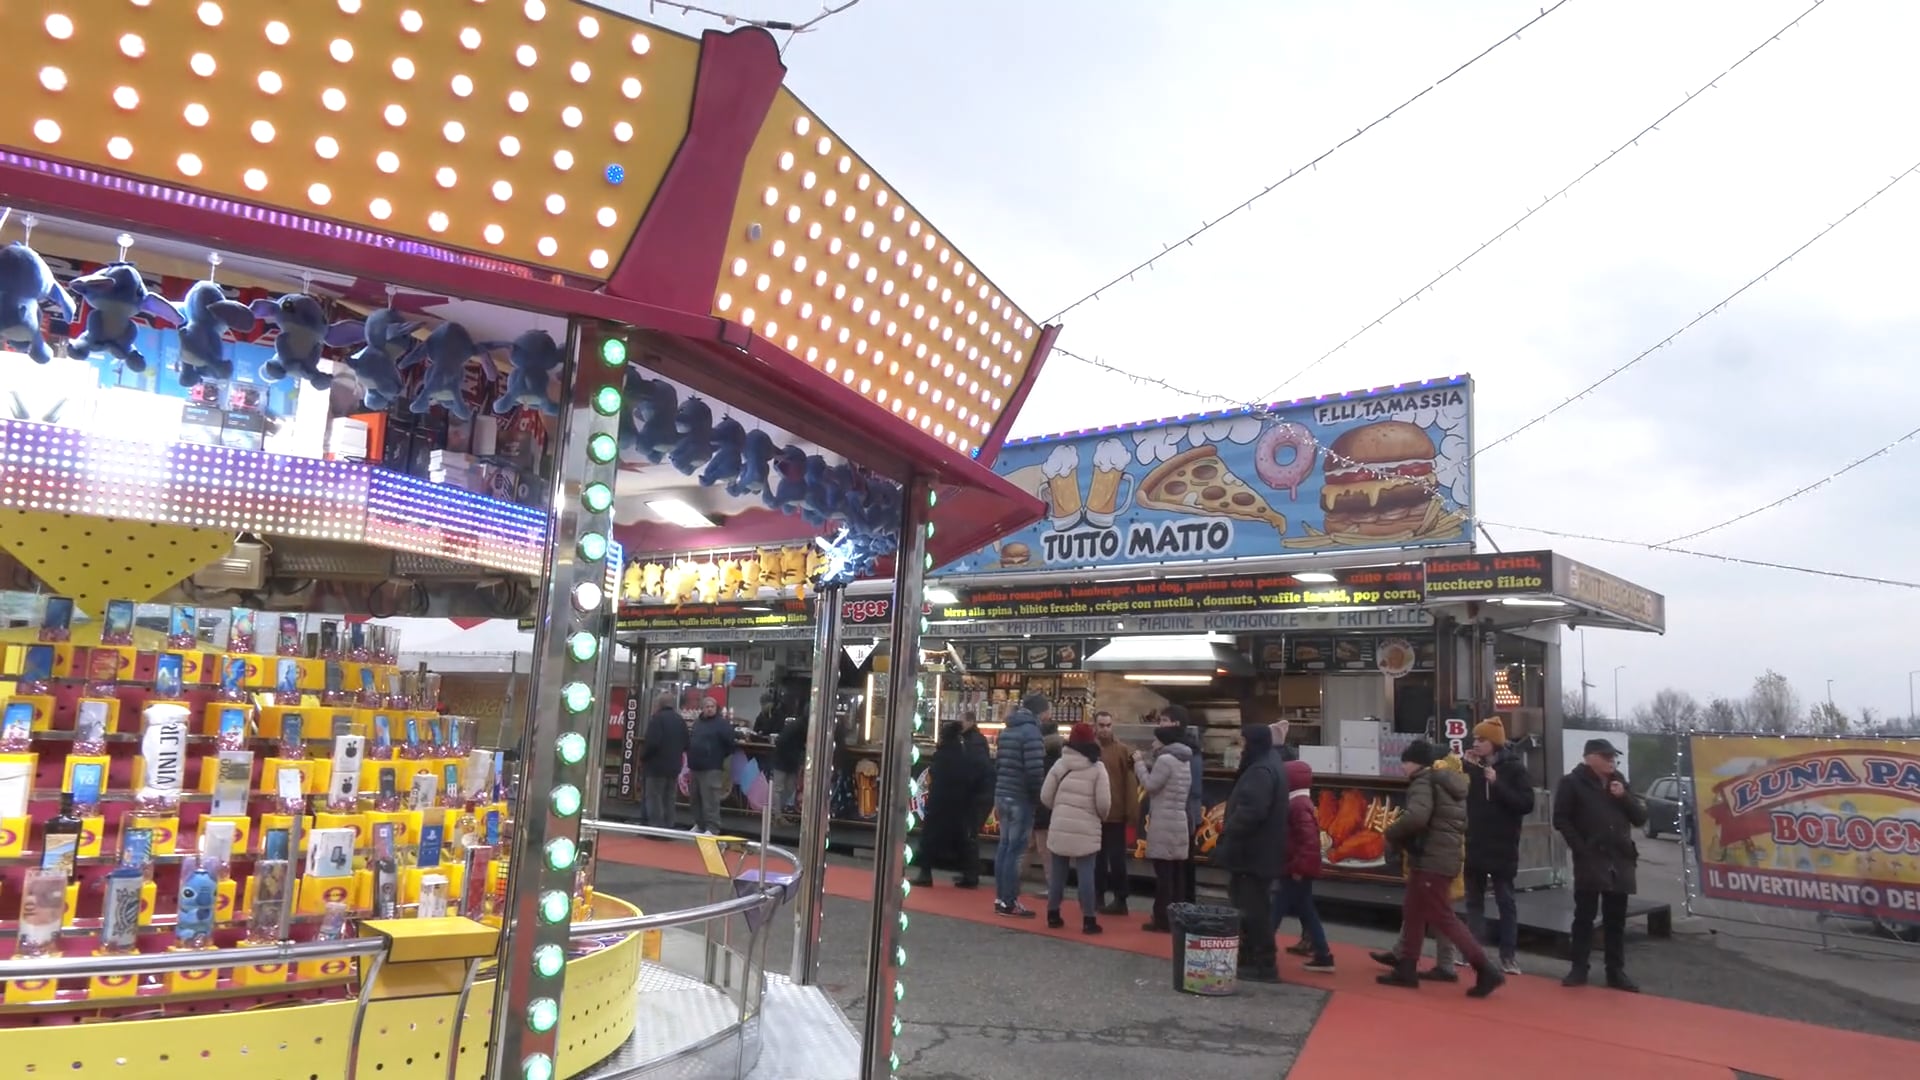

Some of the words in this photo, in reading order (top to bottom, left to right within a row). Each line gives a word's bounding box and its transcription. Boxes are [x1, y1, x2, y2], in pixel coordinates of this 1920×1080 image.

[1319, 403, 1356, 423] F.LLI
[1363, 390, 1464, 417] TAMASSIA
[1044, 530, 1119, 561] TUTTO
[1128, 521, 1230, 556] MATTO
[969, 605, 985, 617] alla
[987, 603, 1013, 618] spina
[1020, 602, 1049, 615] bibite
[1050, 601, 1088, 614] fresche
[1095, 599, 1130, 612] crêpes
[1131, 597, 1151, 609] con
[1154, 596, 1194, 608] nutella
[1203, 593, 1257, 607] donnuts,
[1261, 590, 1301, 603] waffle
[1353, 588, 1381, 603] pop
[1383, 585, 1421, 601] corn,
[1425, 577, 1493, 592] zucchero
[1497, 575, 1542, 588] filato
[1007, 620, 1065, 633] PATATINE
[1071, 618, 1116, 632] FRITTE
[1138, 616, 1194, 631] PIADINE
[1203, 612, 1299, 630] ROMAGNOLE
[1337, 608, 1427, 626] FRITTELLE
[156, 751, 177, 785] VINI
[621, 763, 632, 794] Bar
[1734, 757, 1860, 813] LUNA
[1709, 869, 1724, 888] IL
[1728, 872, 1880, 905] DIVERTIMENTO
